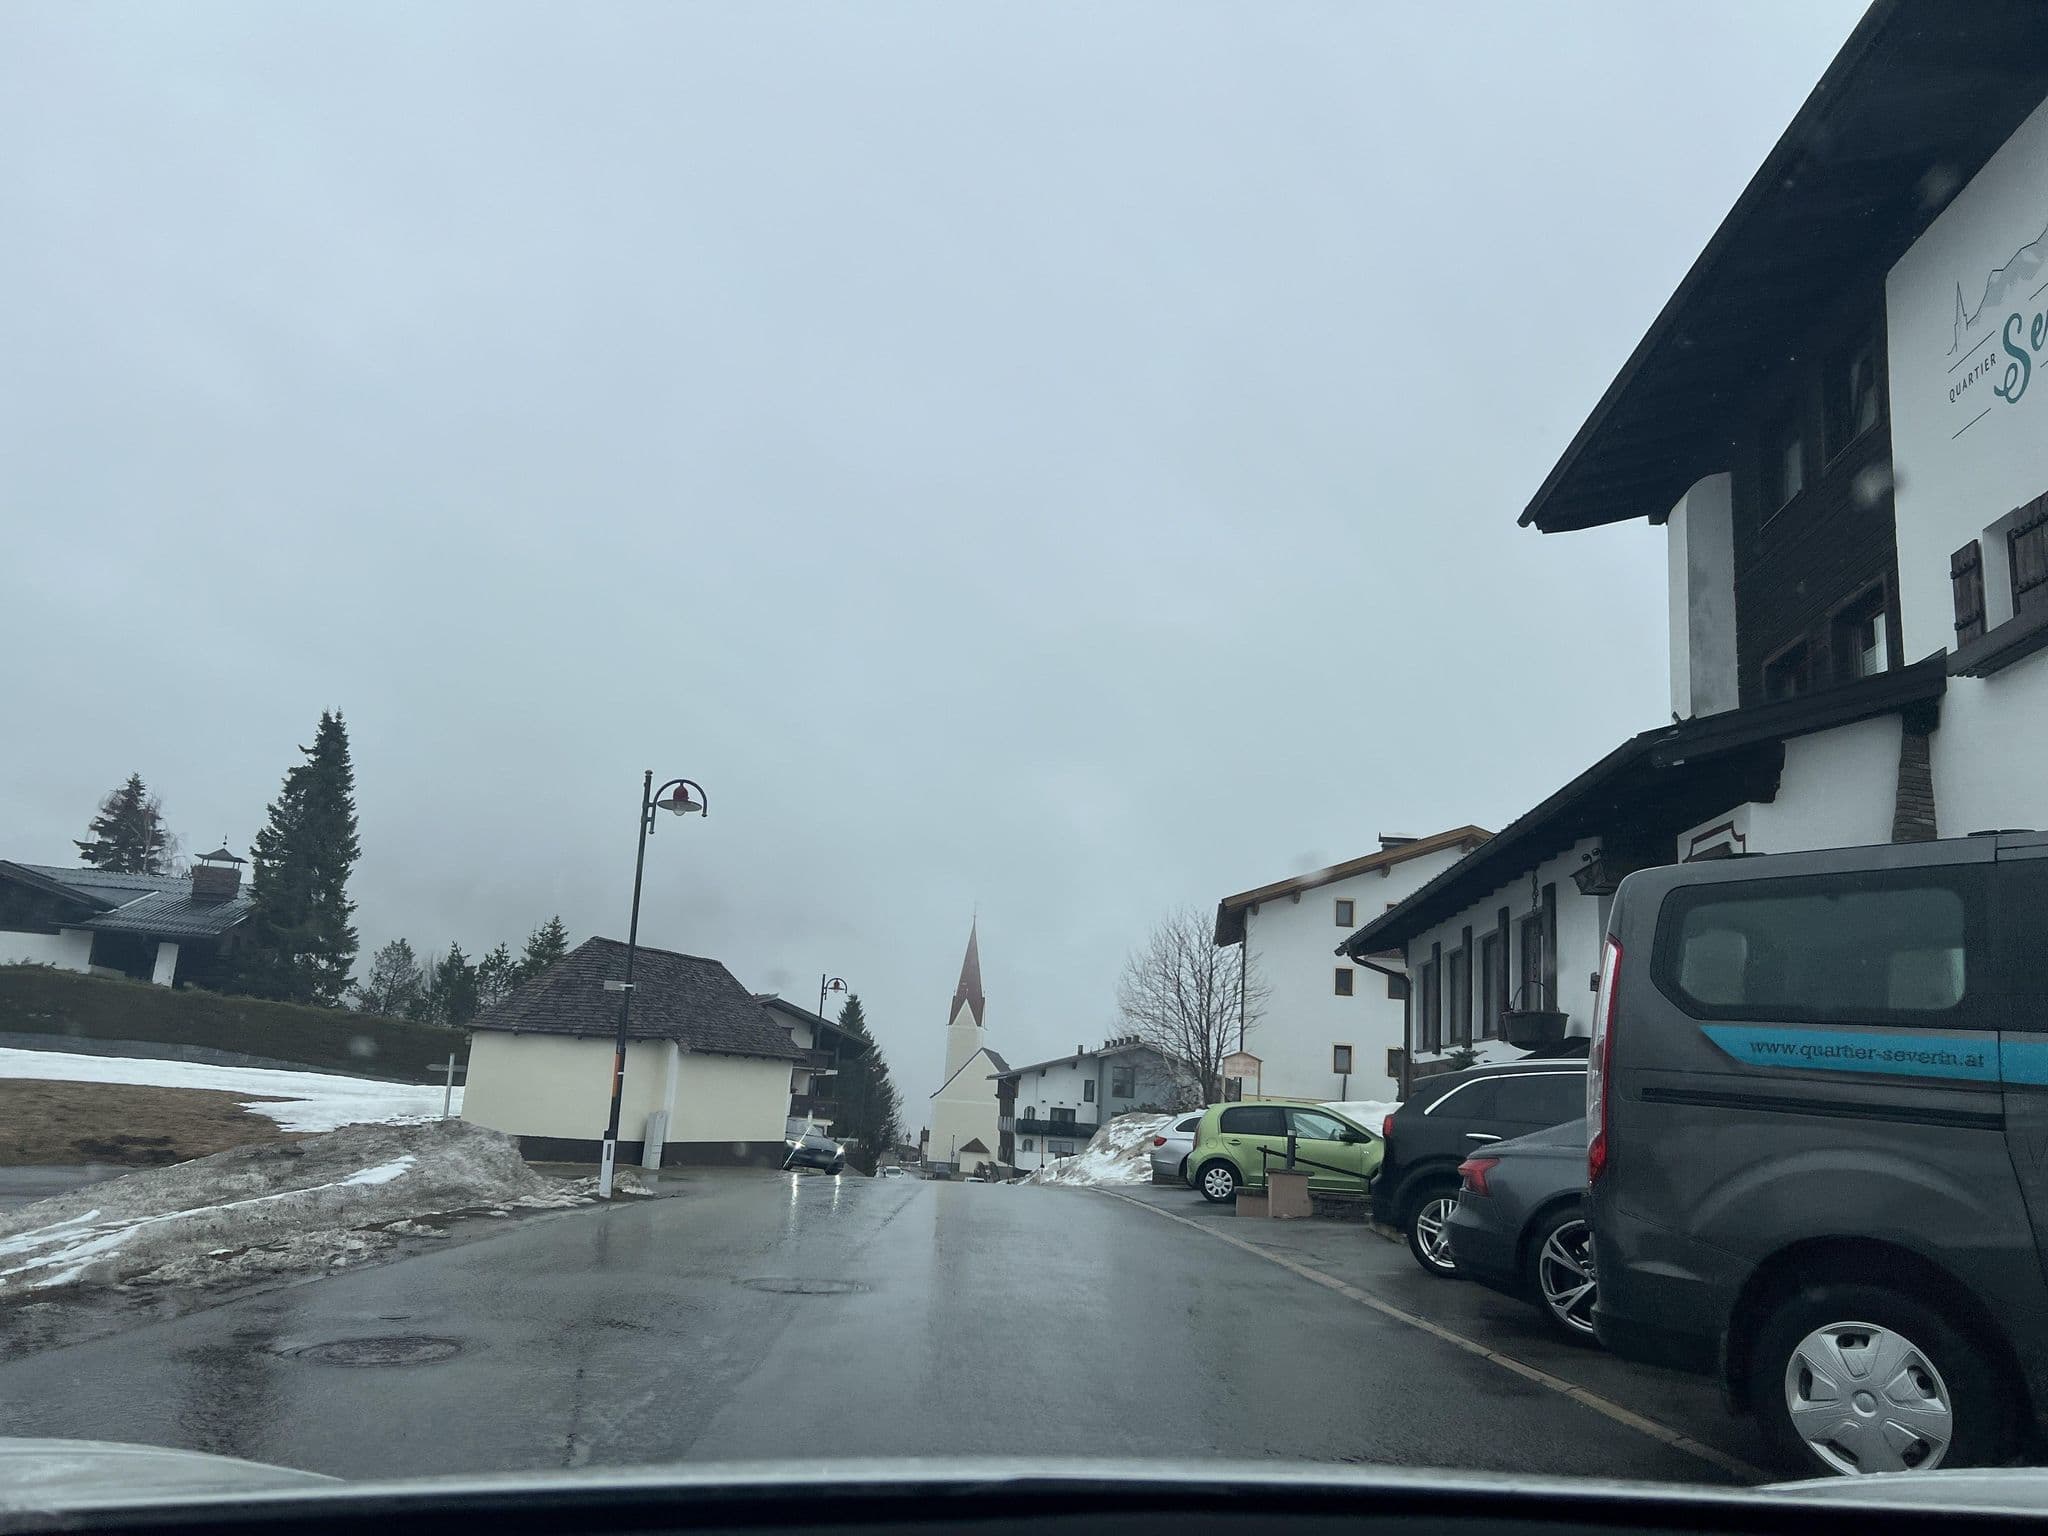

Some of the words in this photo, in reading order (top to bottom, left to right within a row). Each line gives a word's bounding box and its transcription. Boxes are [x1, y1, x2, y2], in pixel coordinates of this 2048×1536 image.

[1949, 353, 1996, 403] QUARTIER
[1994, 310, 2048, 404] Se
[1750, 1041, 1985, 1067] www.quartier-severin.at
